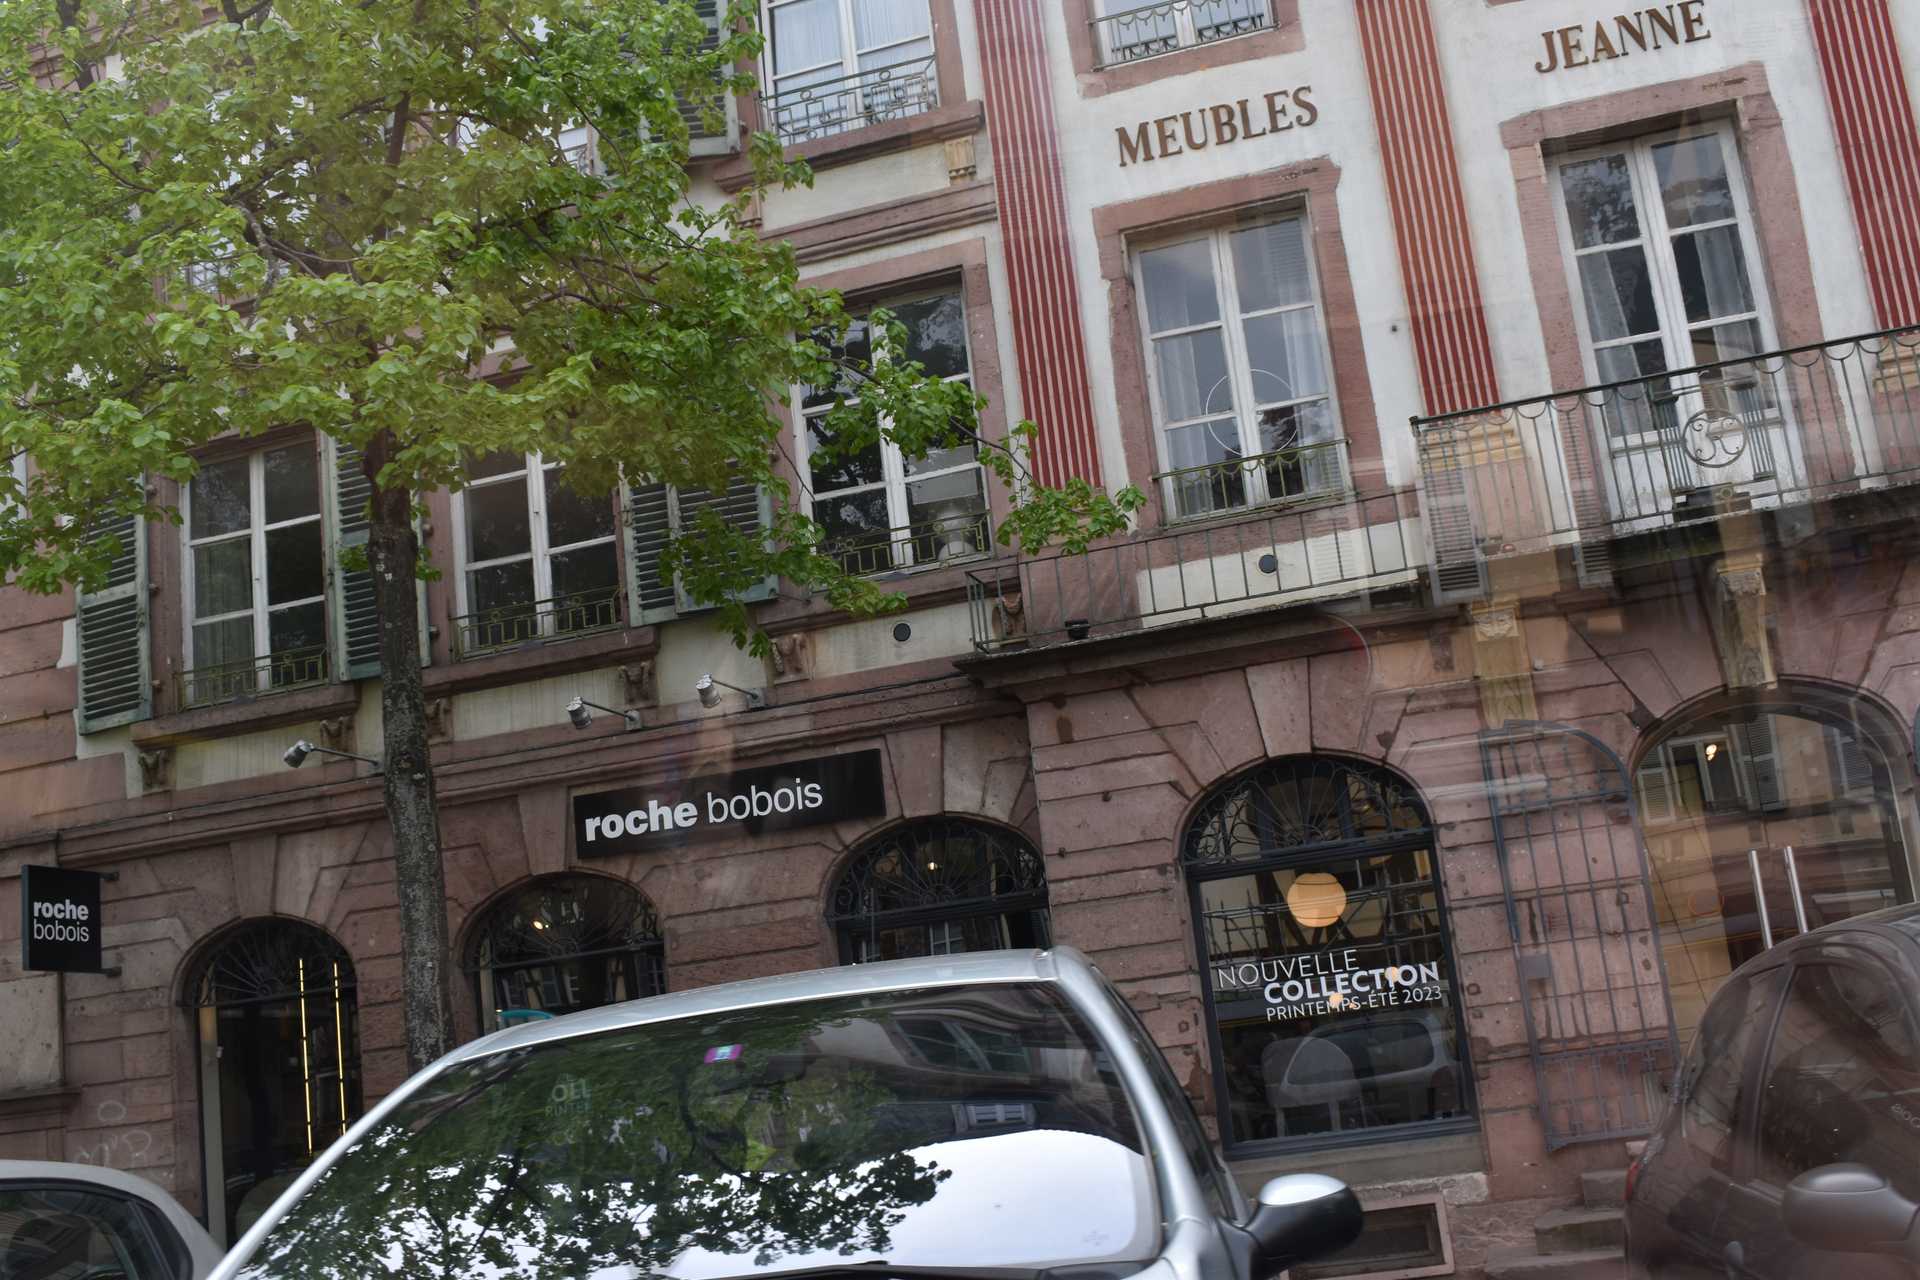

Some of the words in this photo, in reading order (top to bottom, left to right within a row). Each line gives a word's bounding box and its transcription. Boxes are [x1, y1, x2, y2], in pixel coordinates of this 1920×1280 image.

[1535, 0, 1711, 74] JEANNE
[1115, 86, 1318, 167] MEUBLES
[585, 800, 698, 841] roche
[707, 778, 823, 823] bobois
[33, 899, 89, 921] roche
[33, 919, 90, 943] bobois
[1218, 949, 1360, 988] NOUVELLE
[1264, 961, 1439, 1003] COLLECTION
[1403, 985, 1442, 1004] 2023
